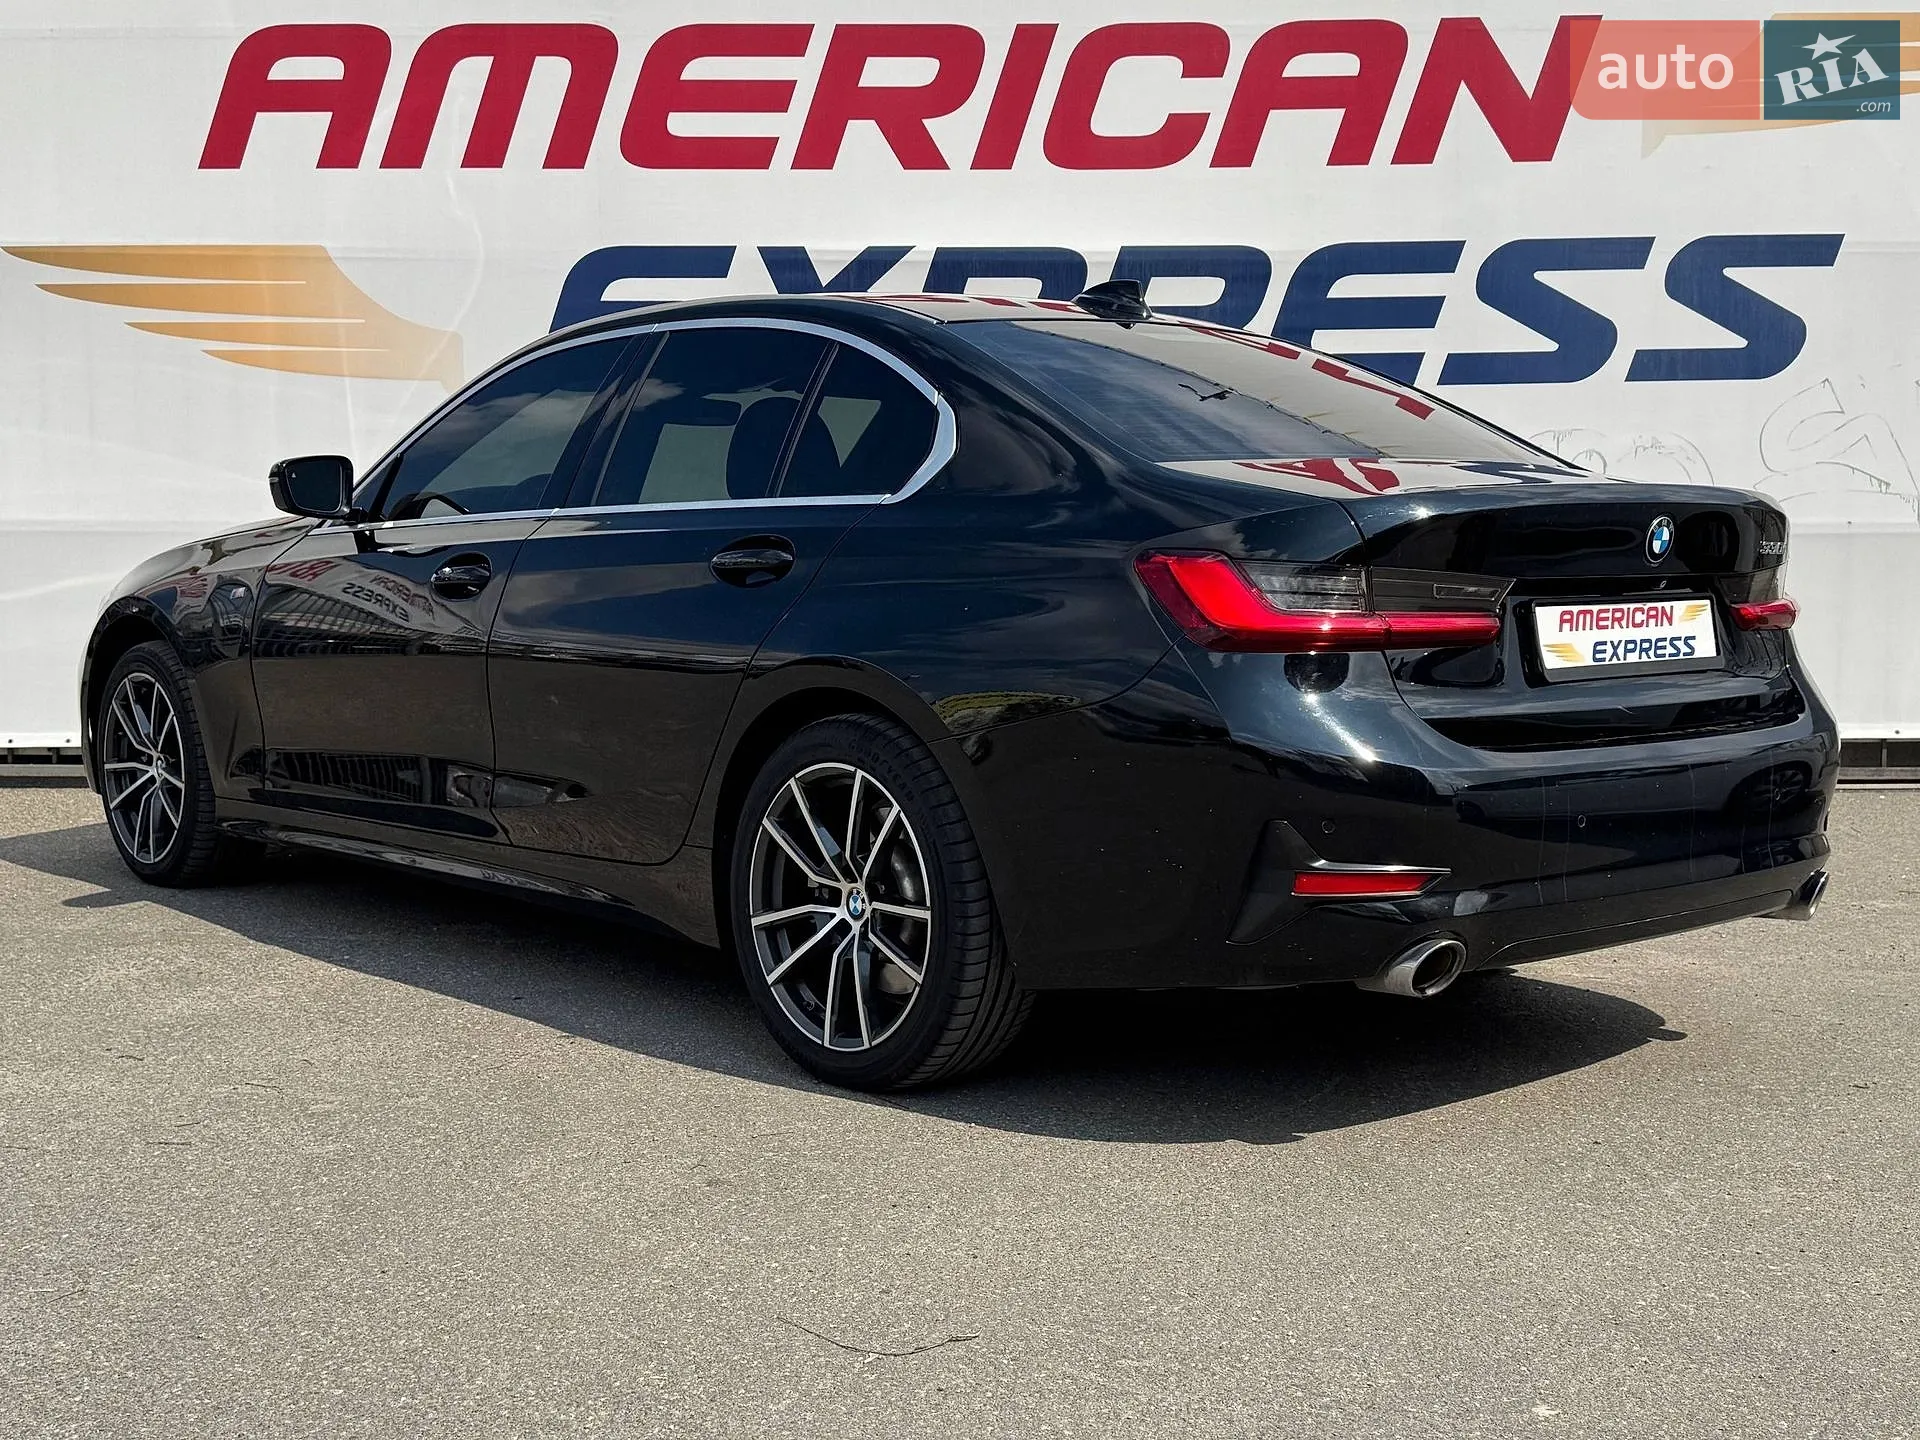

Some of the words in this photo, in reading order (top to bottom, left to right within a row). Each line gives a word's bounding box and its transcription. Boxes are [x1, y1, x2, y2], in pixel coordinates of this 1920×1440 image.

[198, 15, 1603, 170] AMERICAN
[1558, 605, 1674, 632] AMERICAN
[1592, 635, 1696, 662] EXPRESS
